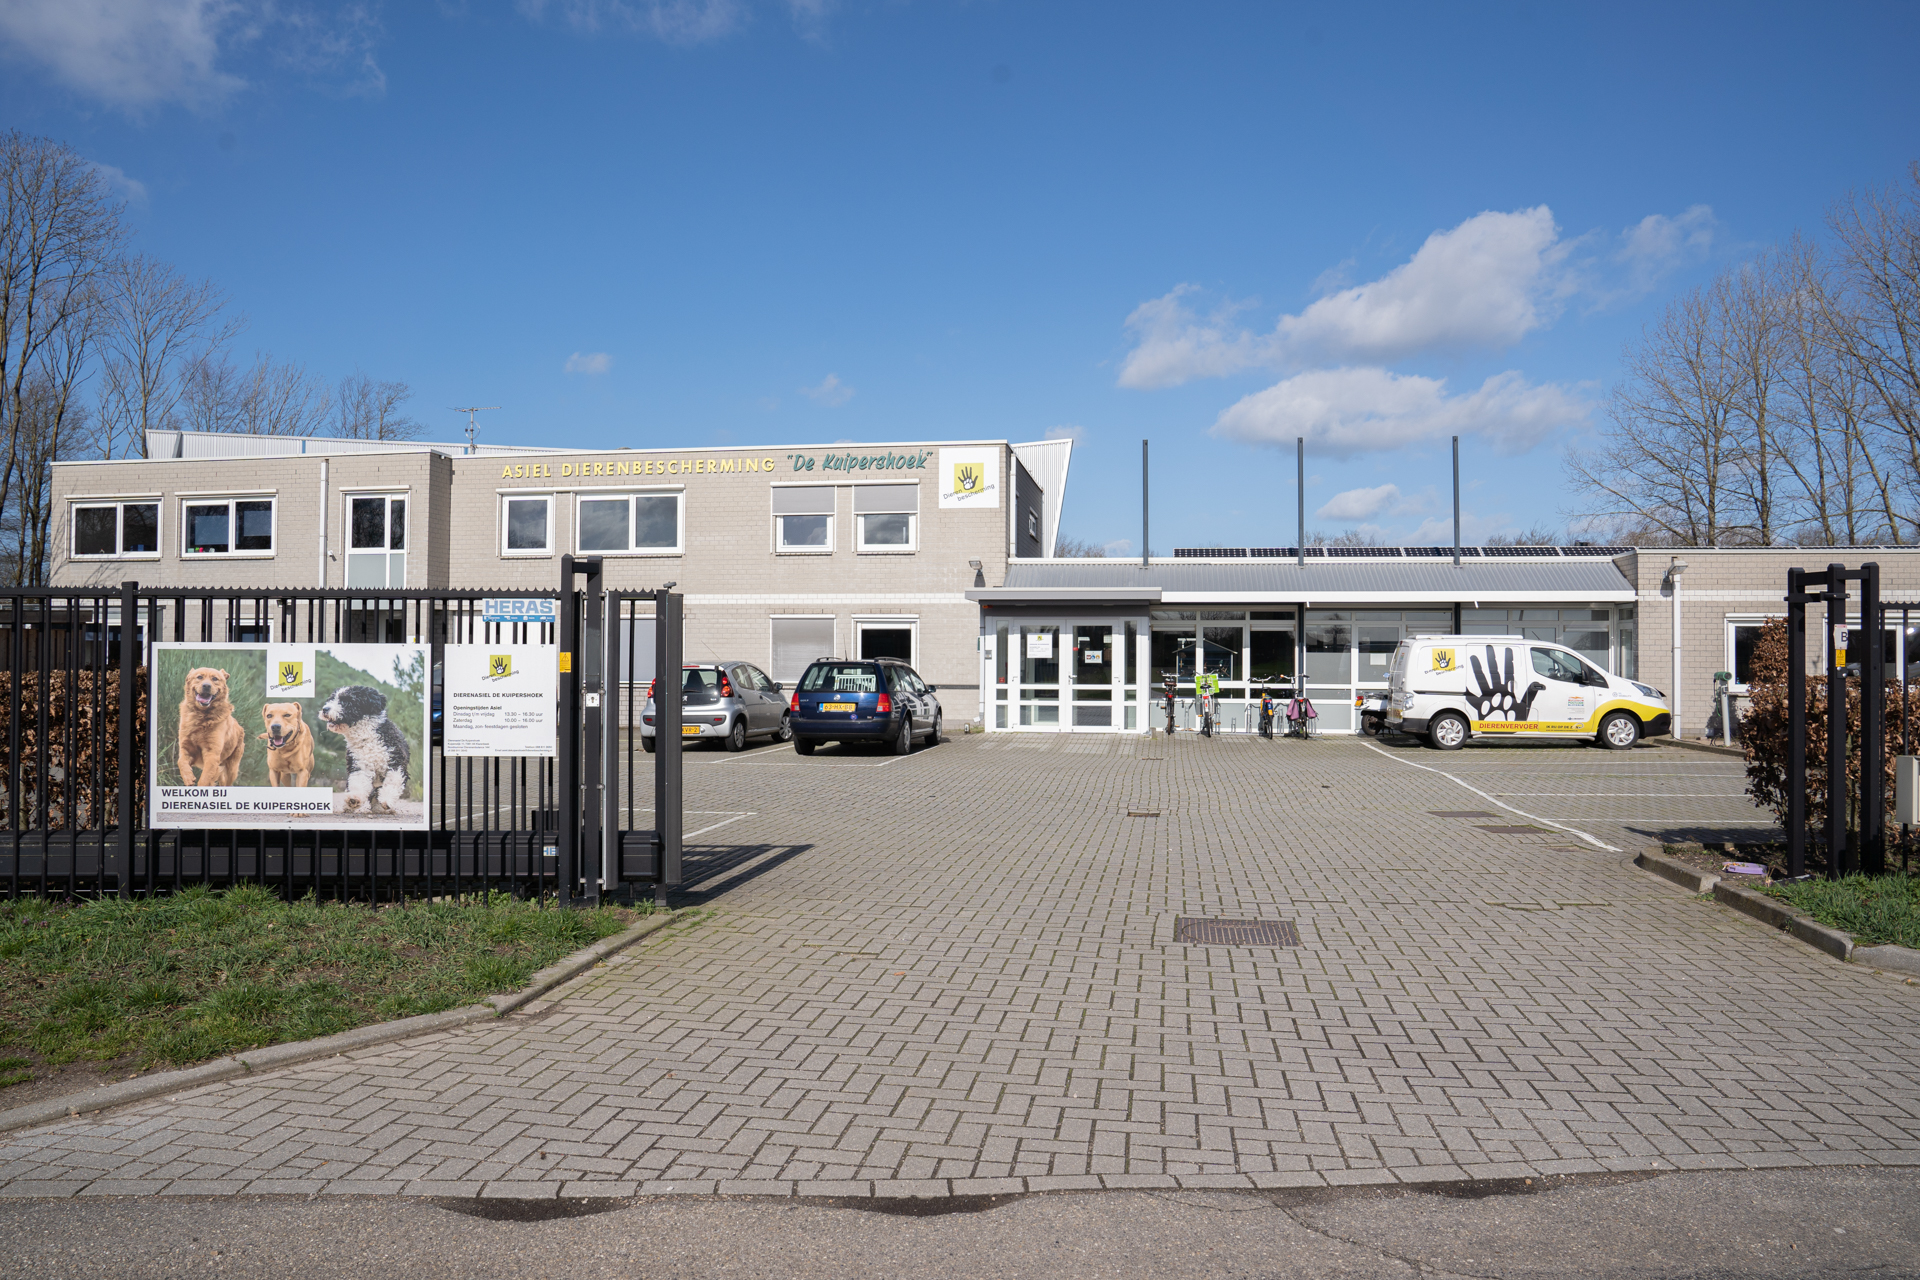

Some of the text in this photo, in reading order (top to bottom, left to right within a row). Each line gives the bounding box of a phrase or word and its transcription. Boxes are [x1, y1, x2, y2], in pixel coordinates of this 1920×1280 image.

[501, 464, 552, 479] ASIEL
[562, 457, 776, 478] DIERENBESCHERMING
[943, 488, 963, 500] Dieren
[957, 484, 996, 502] bescherming
[485, 600, 553, 614] HERAS
[481, 673, 496, 681] Dieren
[491, 669, 520, 683] bescherming
[269, 682, 286, 690] Dieren
[281, 678, 312, 692] bescherming
[1479, 722, 1539, 730] DIERENVERVOER
[161, 788, 227, 797] WELKOM BIJ
[161, 801, 331, 811] DIERENASIEL DE KUIPERSHOEK
